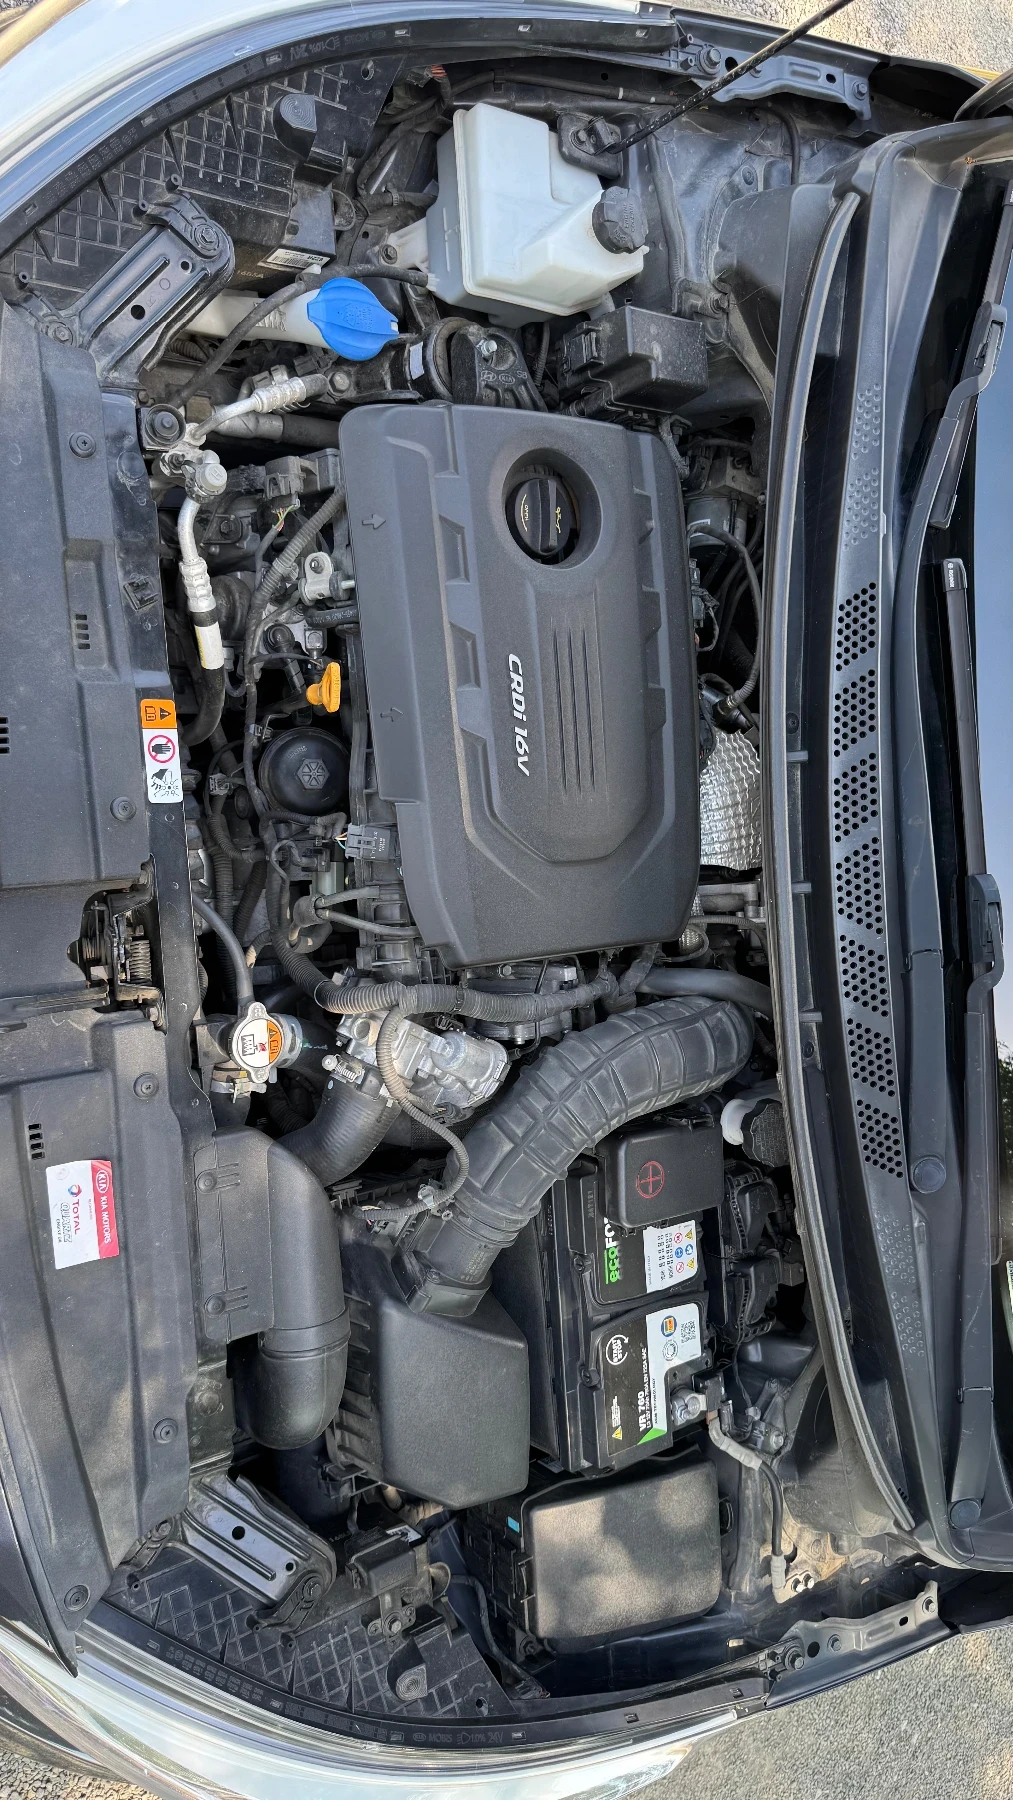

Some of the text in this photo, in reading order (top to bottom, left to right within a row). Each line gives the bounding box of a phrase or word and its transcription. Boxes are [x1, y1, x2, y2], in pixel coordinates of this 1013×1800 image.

[508, 653, 530, 777] CRDi 16V
[60, 1202, 72, 1243] QUARTZ
[72, 1199, 81, 1235] TOTAL
[100, 1195, 112, 1244] KIA MOTORS
[637, 1391, 647, 1432] VR 760
